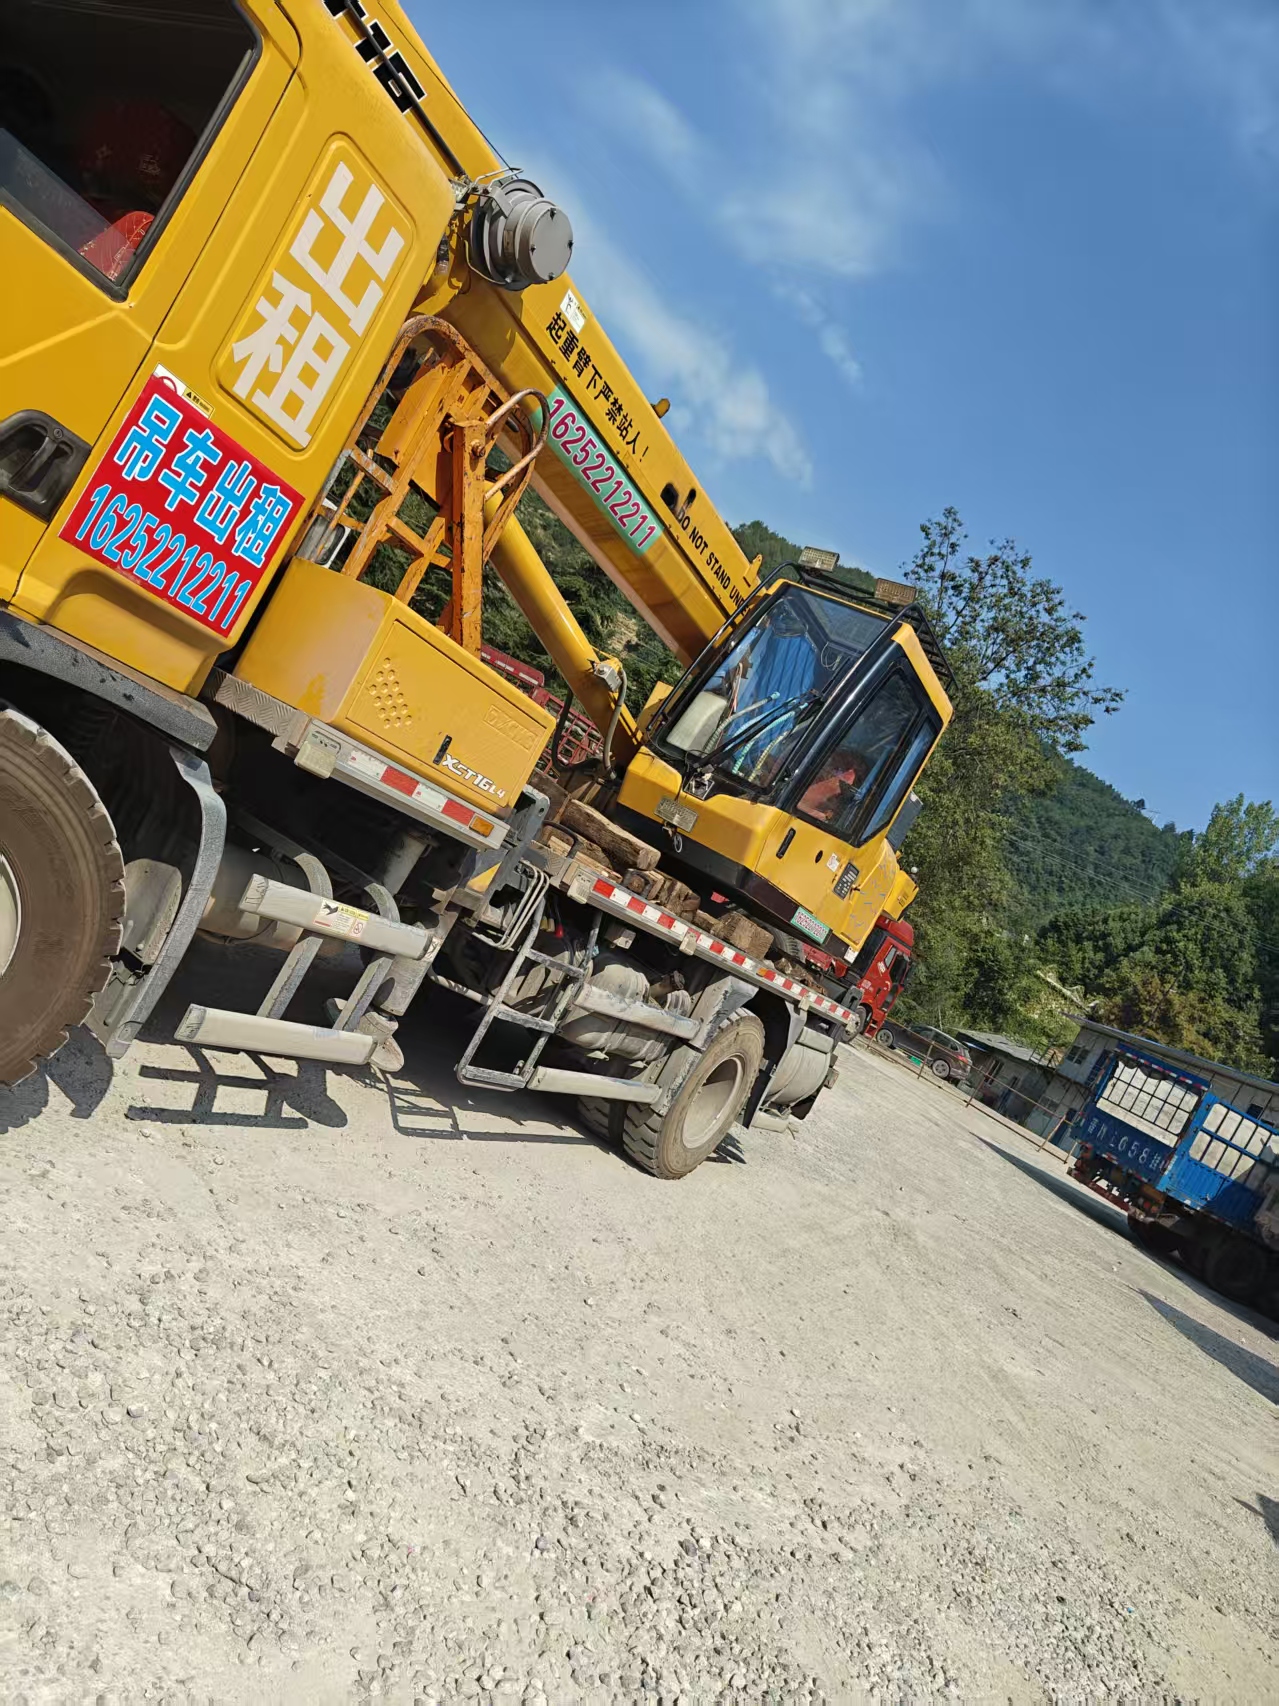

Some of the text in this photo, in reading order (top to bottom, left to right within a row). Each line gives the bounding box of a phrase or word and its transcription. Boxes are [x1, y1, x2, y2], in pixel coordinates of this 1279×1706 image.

[232, 161, 405, 448] 出租
[113, 393, 293, 569] 吊车出租
[549, 397, 657, 549] 16252212211
[75, 483, 252, 630] 16252212211
[689, 526, 708, 555] NOT
[706, 552, 731, 590] STAND
